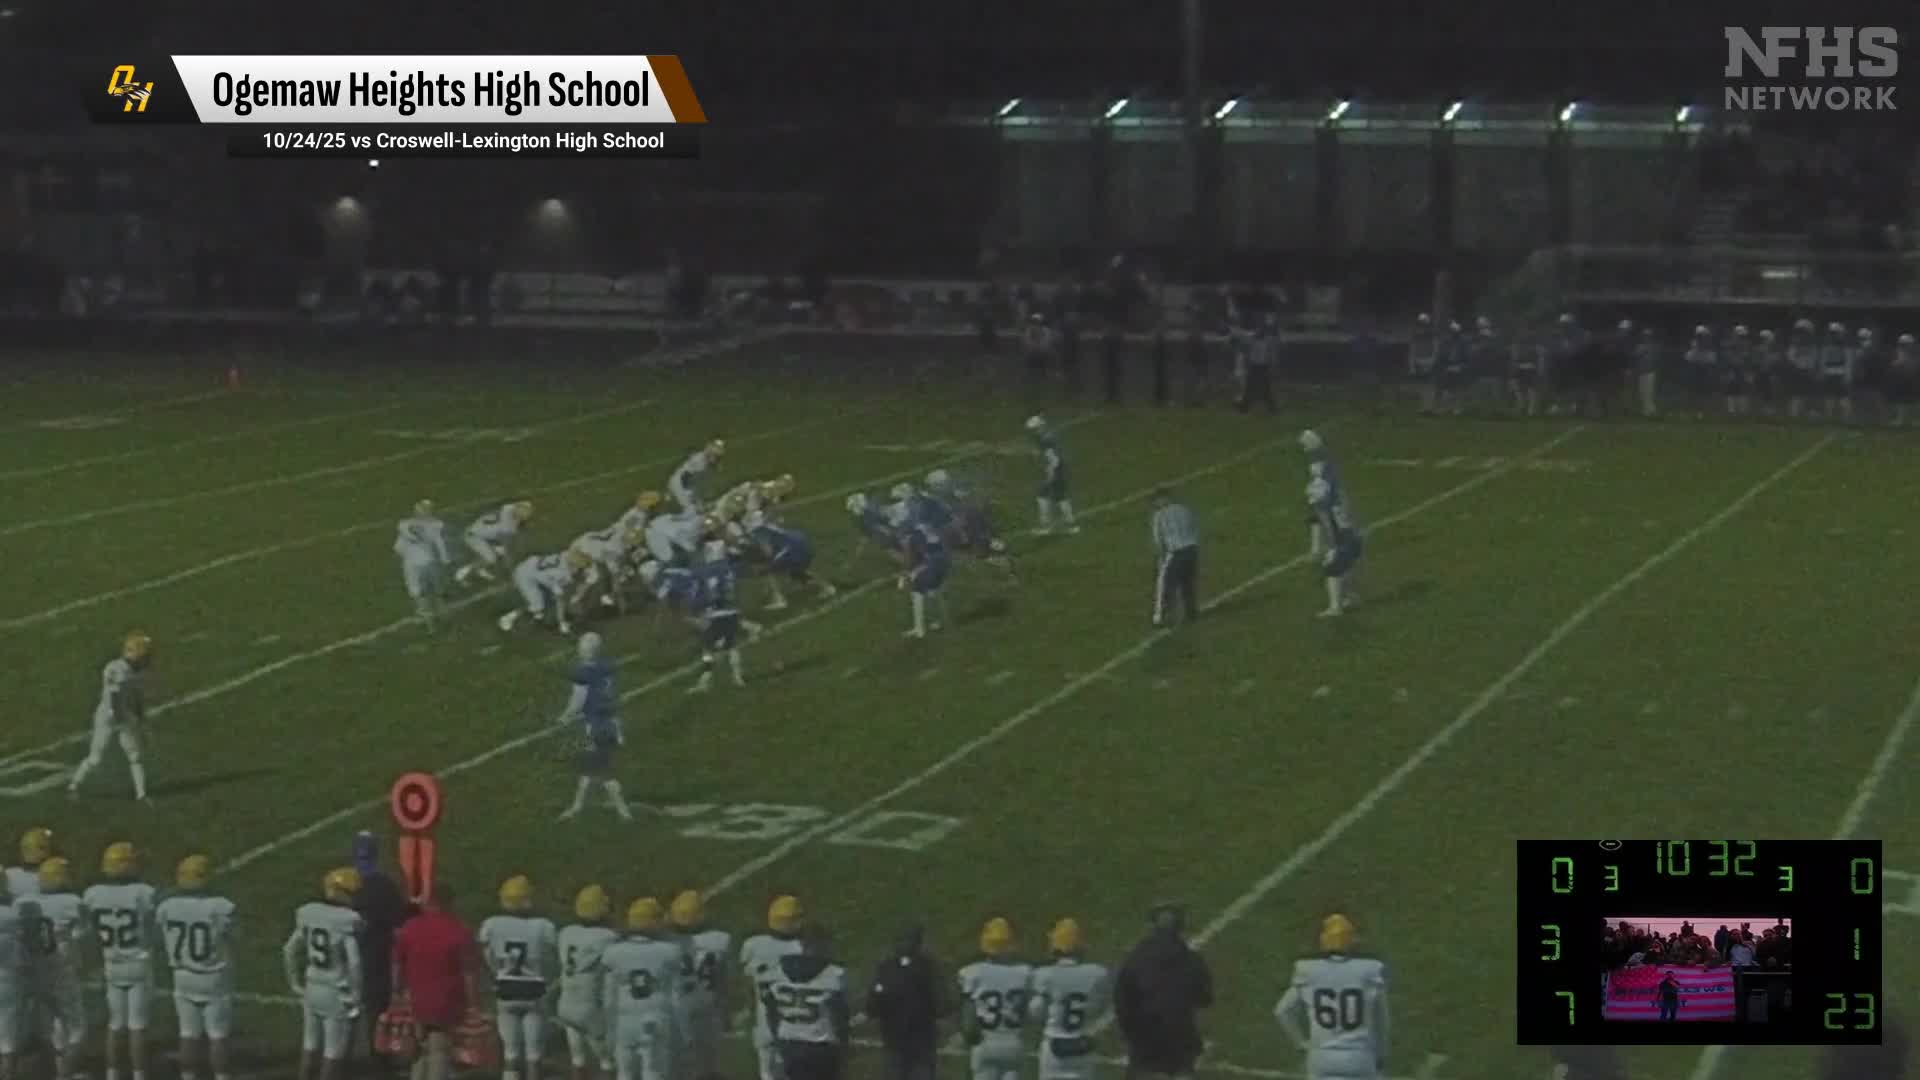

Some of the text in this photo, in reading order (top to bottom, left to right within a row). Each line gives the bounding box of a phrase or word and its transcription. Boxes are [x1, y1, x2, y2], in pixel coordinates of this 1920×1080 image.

[1551, 856, 1574, 894] 0
[1604, 865, 1619, 892] 3
[1779, 865, 1793, 892] 3
[1850, 857, 1874, 895] 0
[95, 907, 138, 948] 52
[167, 919, 212, 962] 70
[1540, 924, 1561, 961] 3
[504, 941, 528, 976] 7
[977, 990, 1024, 1031] 33
[1313, 987, 1364, 1032] 60
[1554, 991, 1575, 1026] 7
[1823, 992, 1875, 1030] 23
